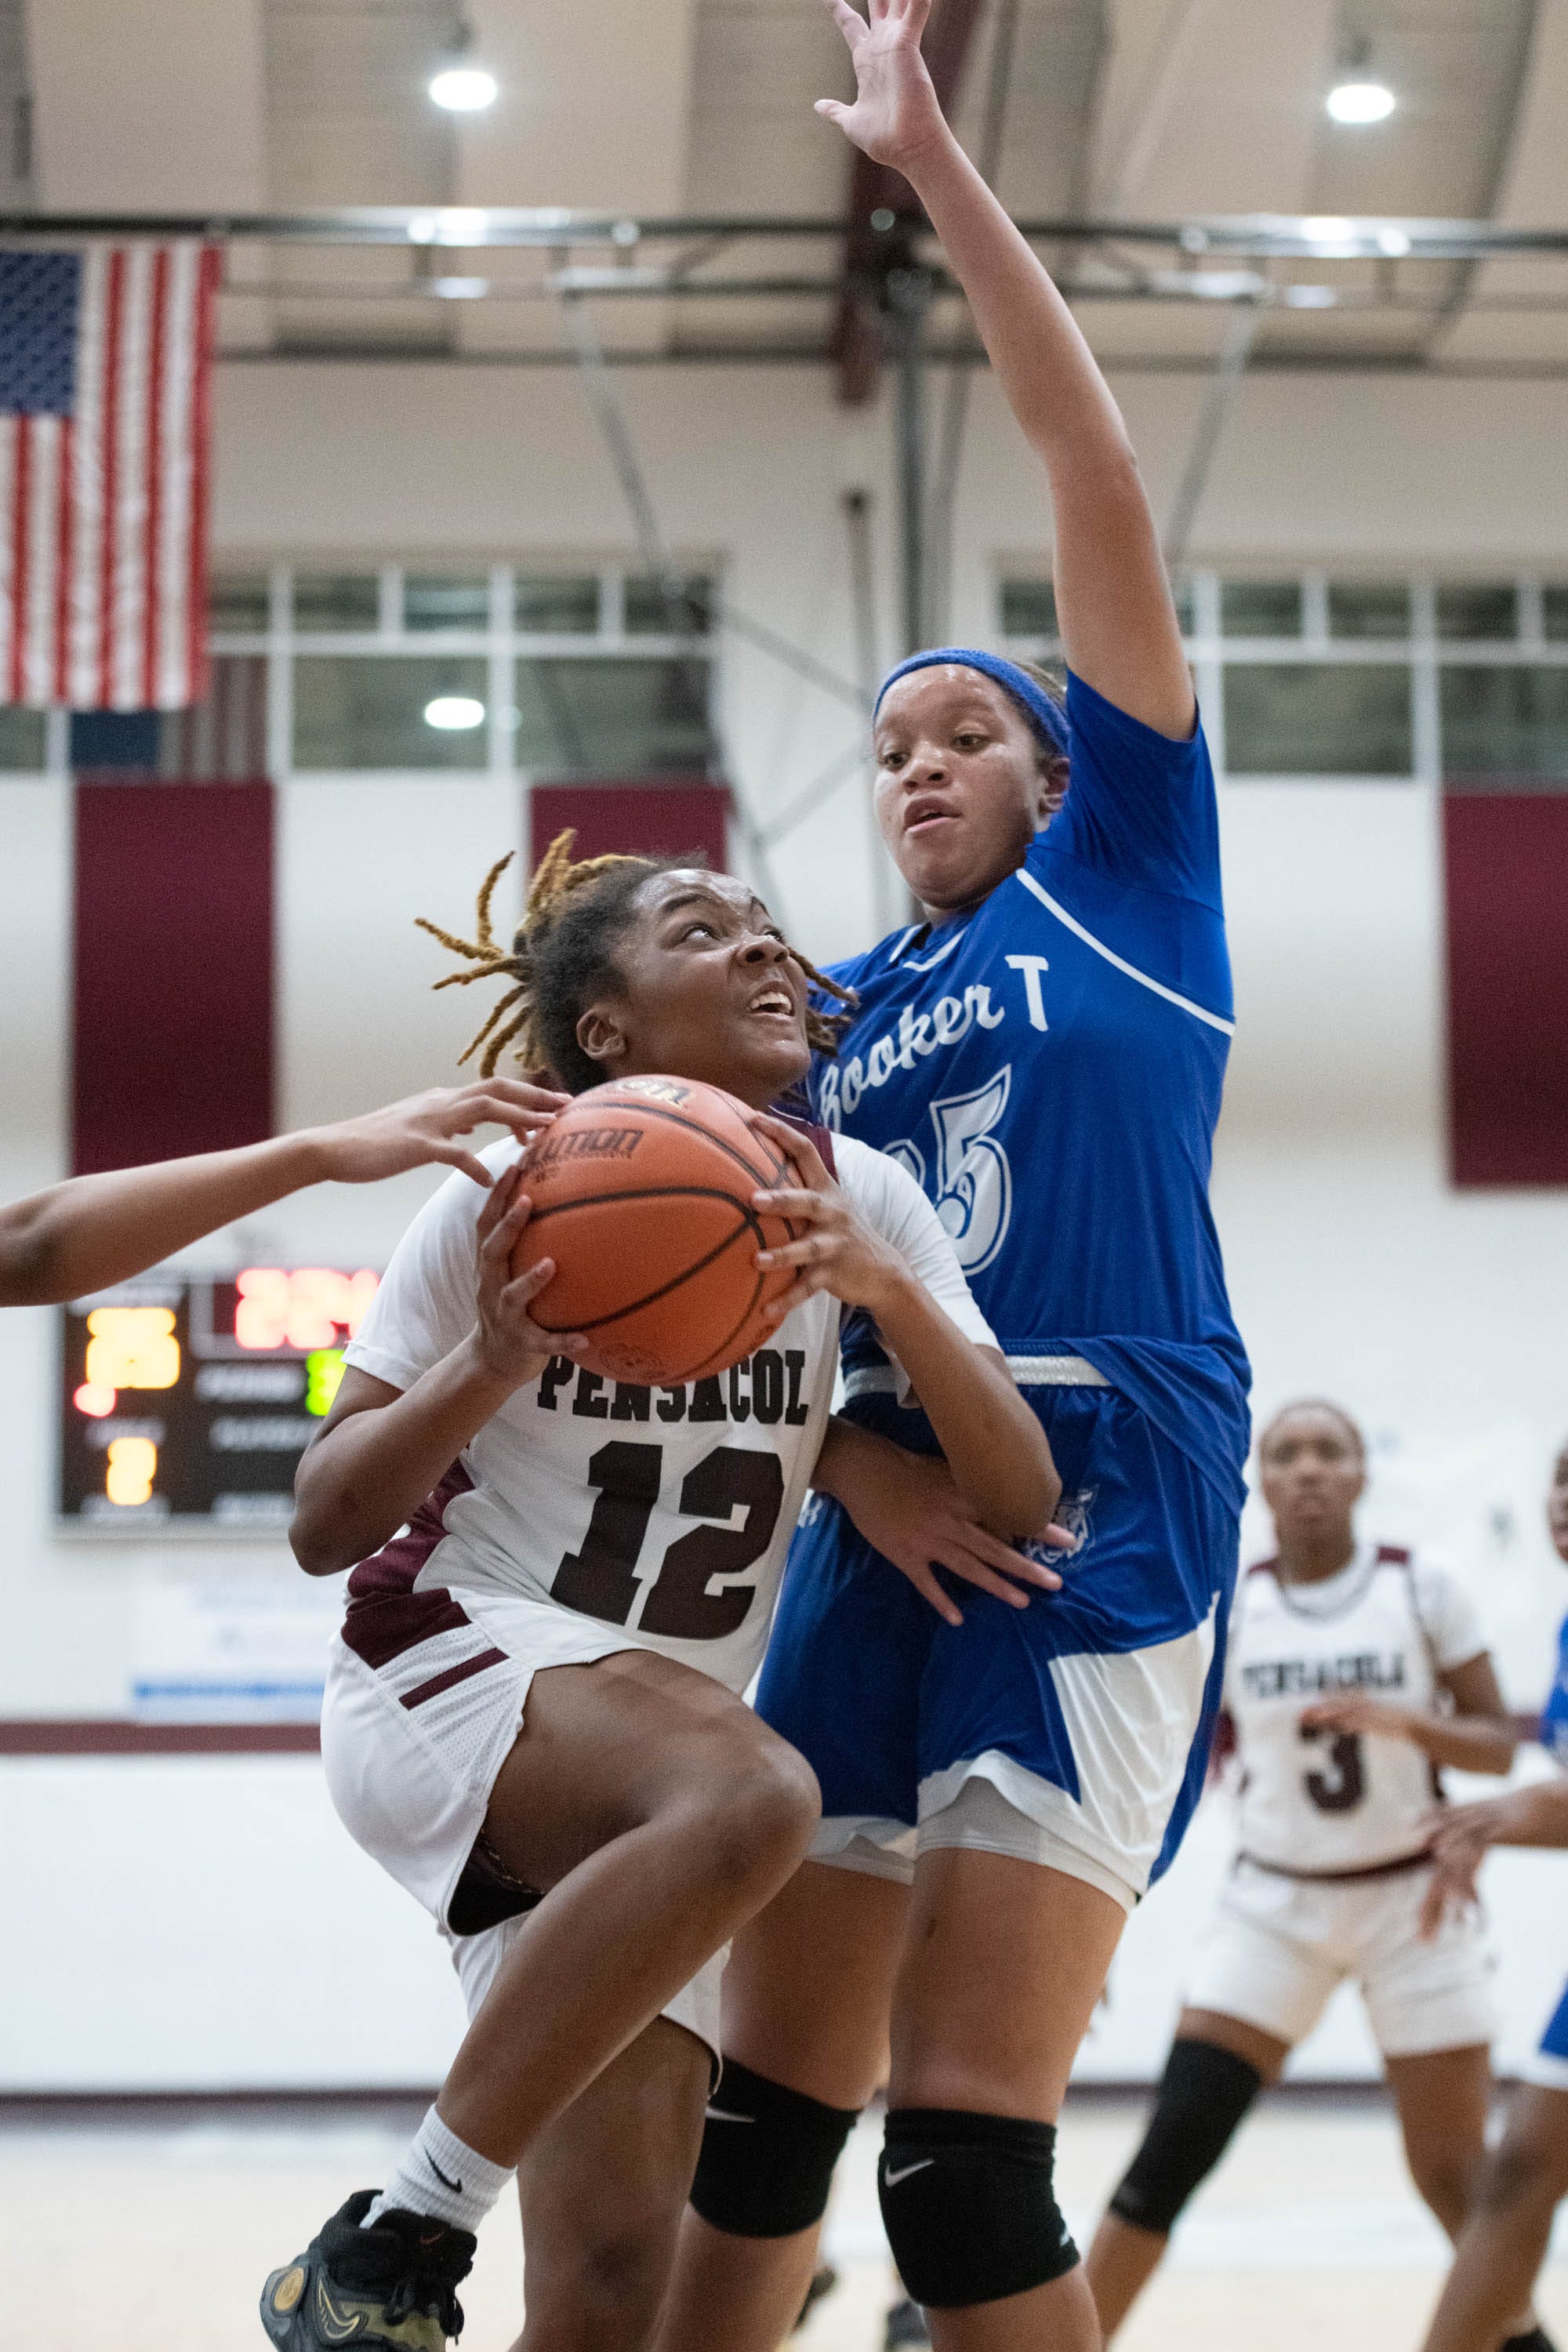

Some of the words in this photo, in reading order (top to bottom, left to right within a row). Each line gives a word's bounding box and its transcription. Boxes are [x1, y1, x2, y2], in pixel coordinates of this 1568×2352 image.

[1005, 954, 1049, 1032] T
[884, 1062, 1013, 1276] 5
[549, 1440, 785, 1641] 12
[1299, 1719, 1364, 1814] 3
